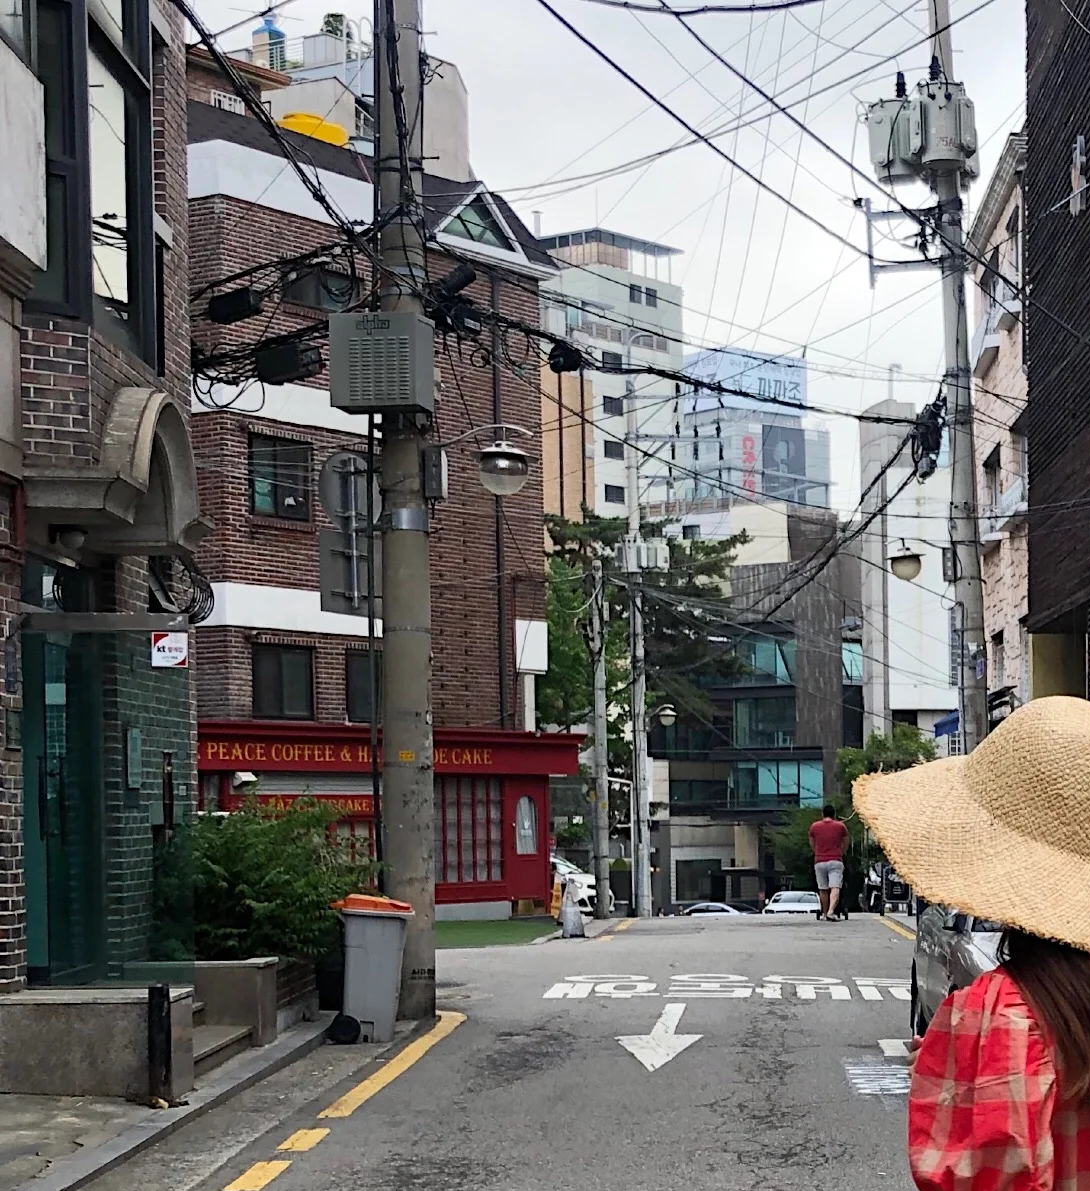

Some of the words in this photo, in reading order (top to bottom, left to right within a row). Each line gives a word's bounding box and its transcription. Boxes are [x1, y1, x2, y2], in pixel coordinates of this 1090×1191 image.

[355, 314, 390, 336] alpha
[156, 645, 166, 653] kt
[207, 742, 267, 760] PEACE
[271, 744, 336, 762] COFFEE
[340, 746, 352, 762] &
[452, 748, 493, 765] CAKE
